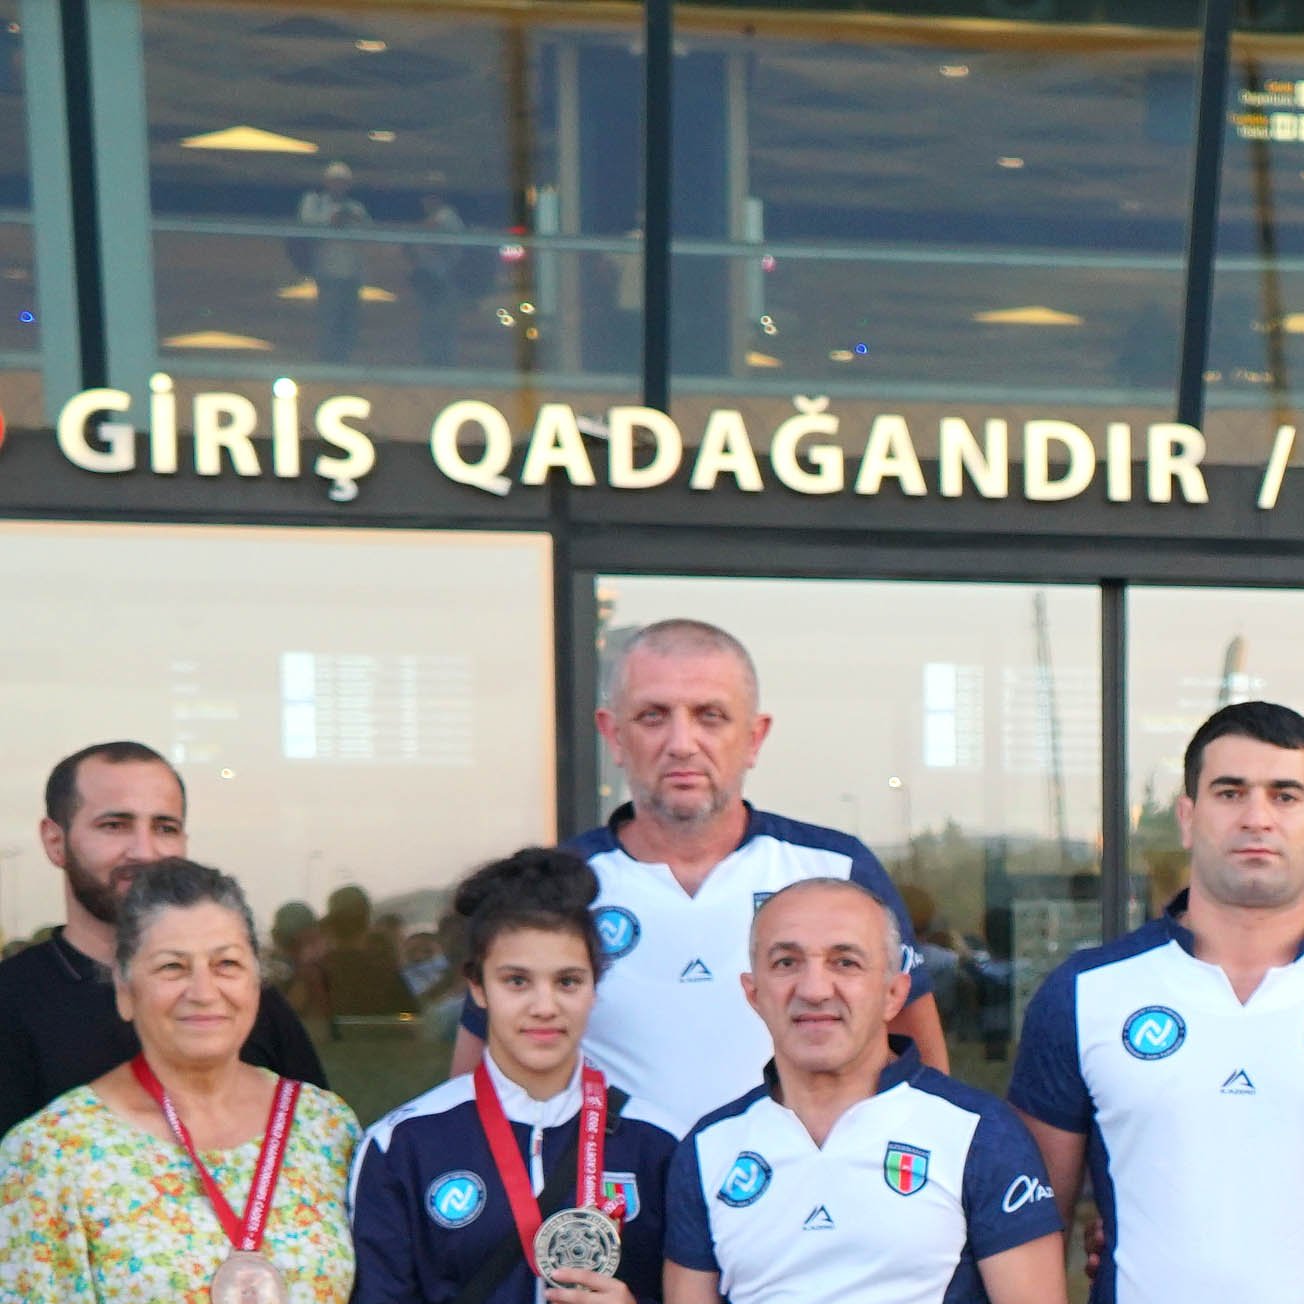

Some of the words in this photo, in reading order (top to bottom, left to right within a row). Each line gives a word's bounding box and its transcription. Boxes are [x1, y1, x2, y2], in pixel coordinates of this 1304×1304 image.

[56, 373, 378, 503] GİRİŞ
[431, 395, 1209, 505] QADAĞANDIR
[1257, 426, 1297, 510] /
[585, 1110, 599, 1133] 2022
[584, 1141, 597, 1174] CADETS
